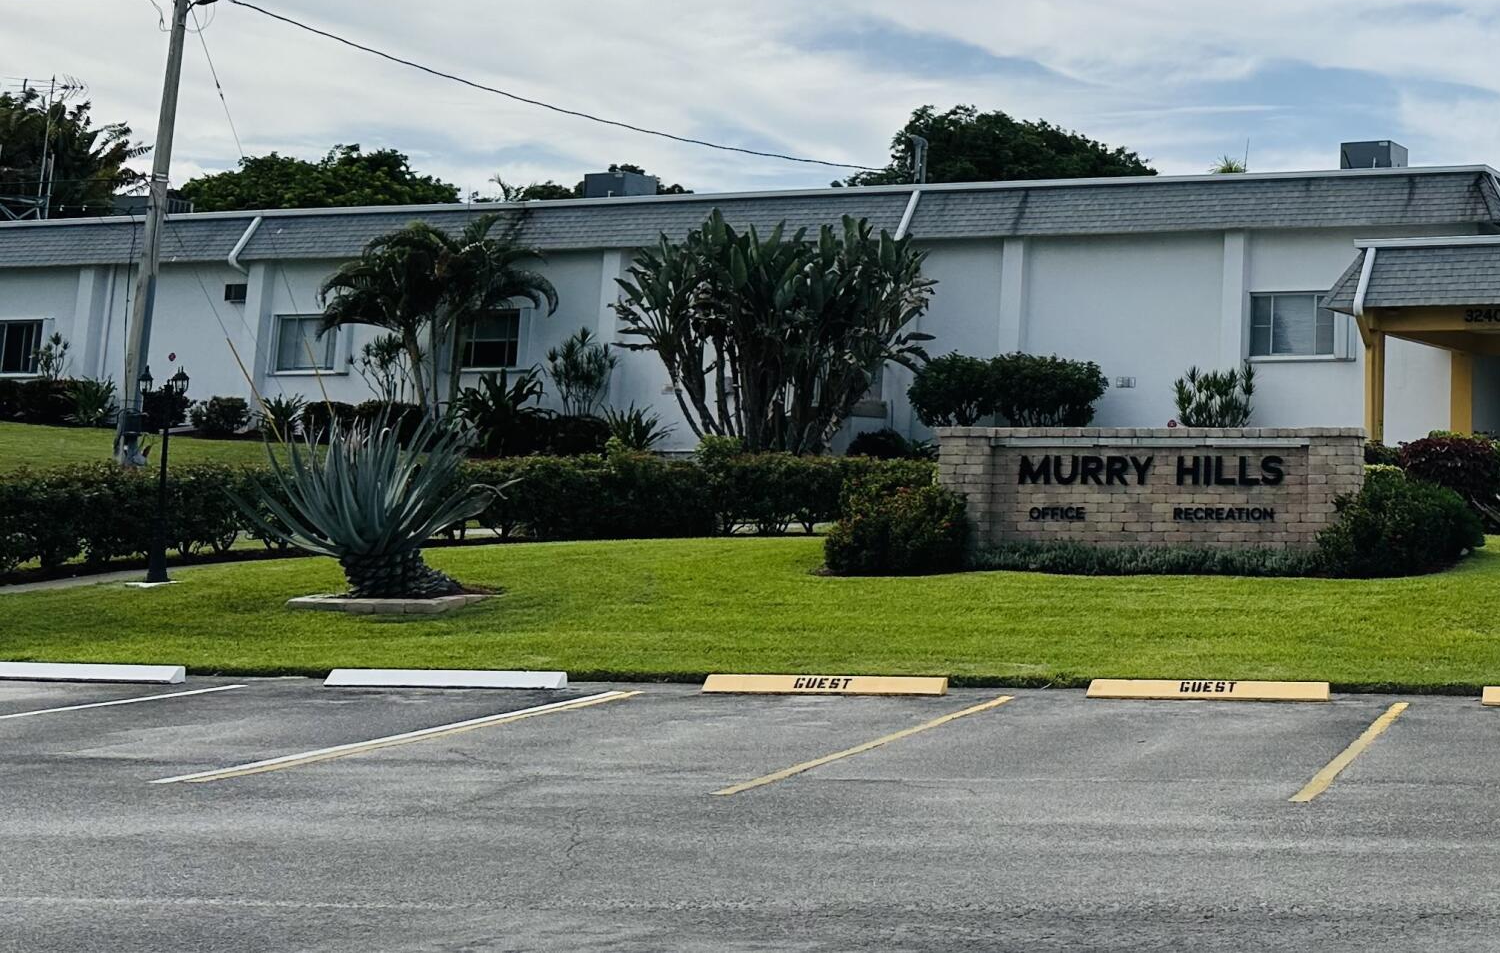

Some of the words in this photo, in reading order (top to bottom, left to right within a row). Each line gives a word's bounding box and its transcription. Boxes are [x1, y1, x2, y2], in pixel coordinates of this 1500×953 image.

[1018, 455, 1154, 485] MURRY
[1177, 455, 1285, 486] HILLS
[1029, 506, 1086, 521] OFFICE
[1173, 507, 1275, 522] RECREATION
[793, 677, 853, 689] GUEST
[1180, 681, 1238, 693] GUEST
